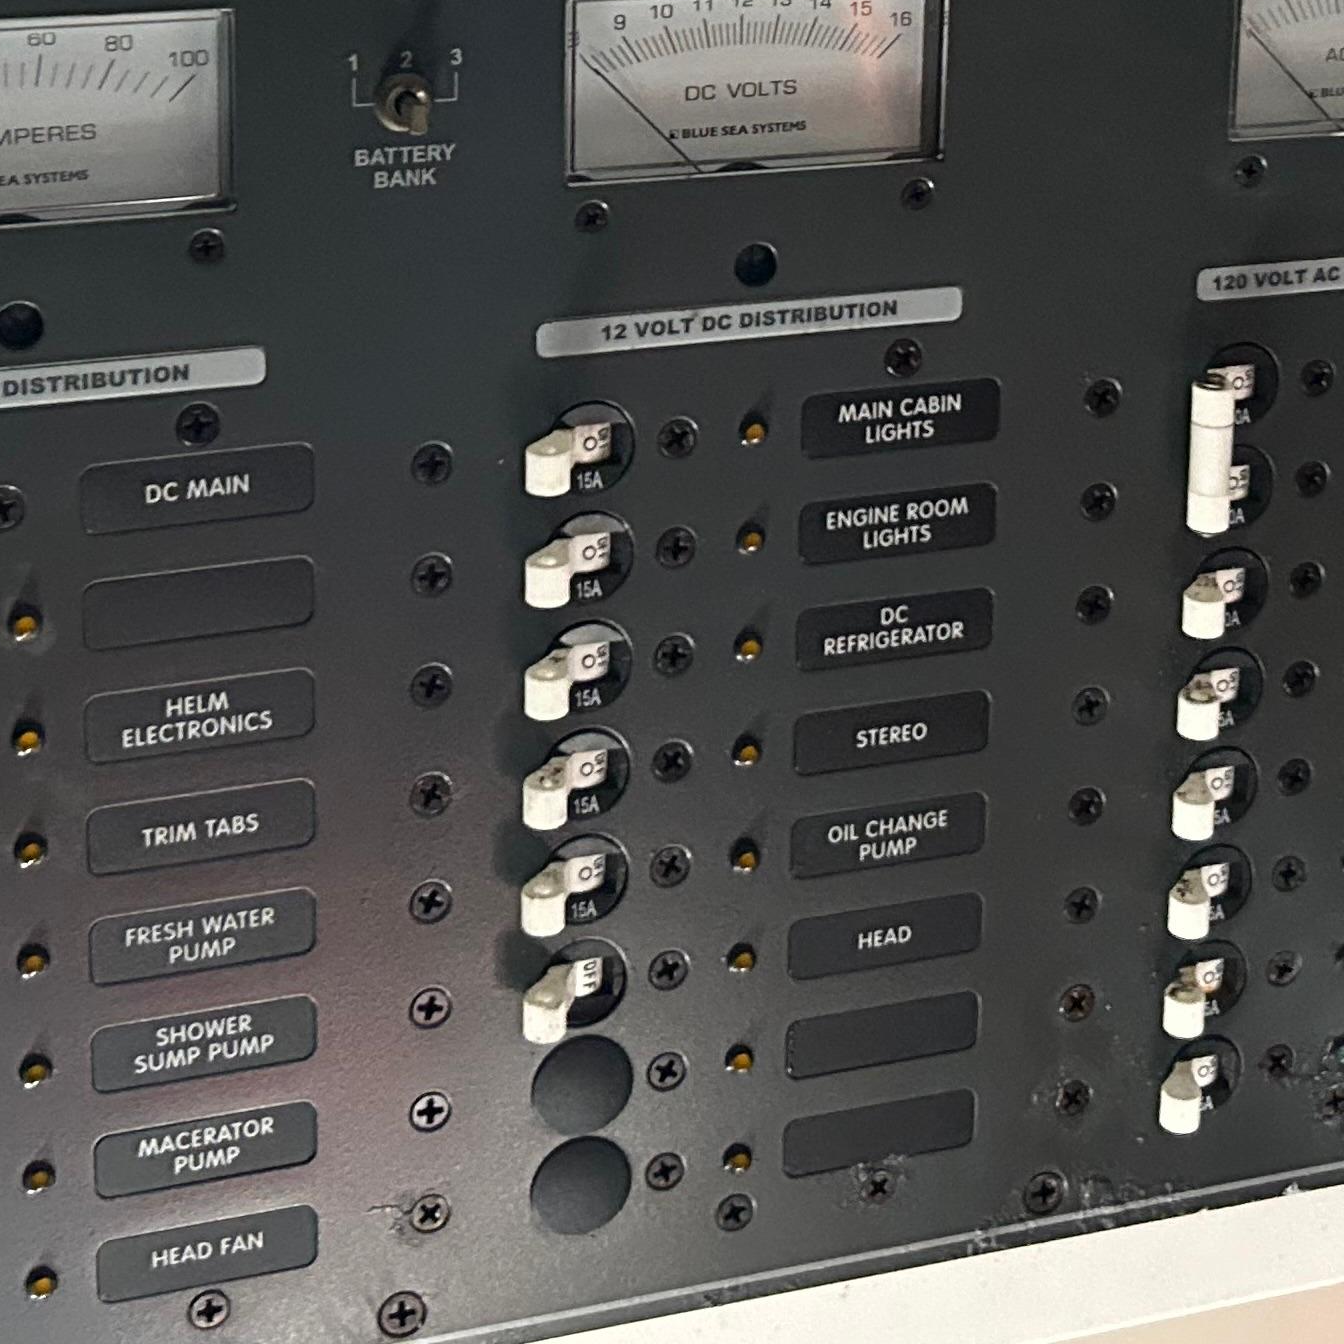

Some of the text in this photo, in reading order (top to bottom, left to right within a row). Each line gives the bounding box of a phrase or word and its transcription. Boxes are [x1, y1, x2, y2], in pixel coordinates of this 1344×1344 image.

[613, 15, 626, 31] 9
[649, 4, 674, 20] 10
[693, 0, 713, 12] 11
[850, 1, 873, 17] 15
[891, 11, 912, 28] 16
[28, 32, 56, 47] 60
[105, 35, 133, 52] 80
[169, 50, 209, 68] 100
[400, 51, 413, 67] 2
[450, 49, 463, 65] 3
[684, 79, 798, 102] DC VOLTS
[682, 120, 807, 139] BLUE SEA SYSTEMS
[353, 143, 455, 167] BATTERY
[23, 170, 89, 186] SYSTEMS
[373, 167, 436, 189] BANK
[1213, 273, 1247, 291] 120
[1254, 268, 1306, 287] VOLT
[1313, 266, 1340, 283] AC
[601, 299, 898, 341] 12 VOLT DC DISTRIBUTION
[3, 364, 190, 398] DISTRIBUTION
[838, 394, 962, 423] MAIN CABIN
[865, 419, 935, 444] LIGHTS
[145, 474, 250, 504] DC MAIN
[576, 471, 604, 490] 15A
[826, 497, 968, 530] ENGINE ROOM
[863, 524, 932, 550] LIGHTS
[576, 579, 603, 599] 15A
[880, 605, 909, 626] DC
[824, 621, 964, 656] REFRIGERATOR
[166, 691, 230, 718] HELM
[574, 687, 601, 707] 15A
[122, 710, 273, 748] ELECTRONICS
[856, 722, 928, 749] STEREO
[573, 795, 600, 815] 15A
[142, 813, 259, 847] TRIM TABS
[828, 810, 948, 844] OIL CHANGE
[858, 837, 917, 862] PUMP
[571, 899, 597, 919] 15A
[125, 907, 275, 947] FRESH WATER
[858, 925, 912, 950] HEAD
[168, 937, 236, 964] PUMP
[156, 1014, 252, 1047] SHOWER
[134, 1034, 275, 1074] SUMP PUMP
[138, 1116, 274, 1157] MACERATOR
[174, 1146, 241, 1175] PUMP
[151, 1232, 264, 1269] HEAD FAN
